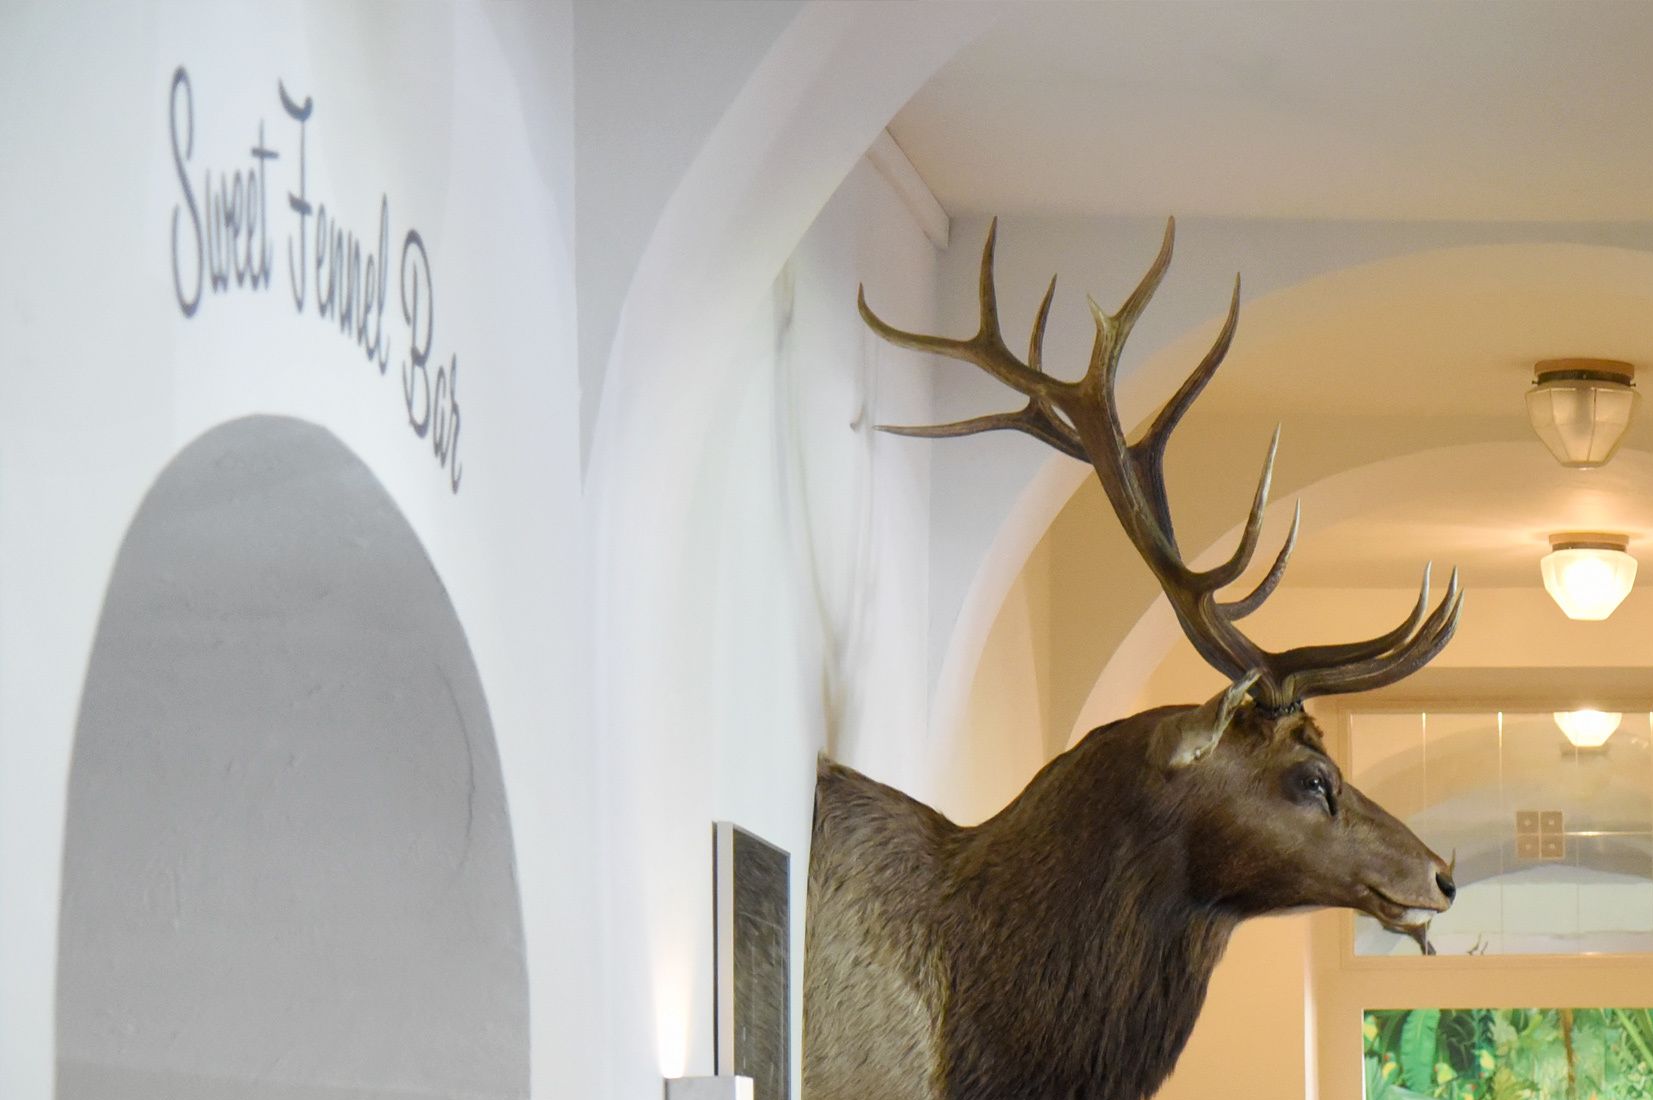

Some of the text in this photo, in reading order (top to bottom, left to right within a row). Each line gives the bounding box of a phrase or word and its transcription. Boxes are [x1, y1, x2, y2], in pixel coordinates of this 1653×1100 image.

[169, 65, 463, 496] Sweet Fennel Bar
